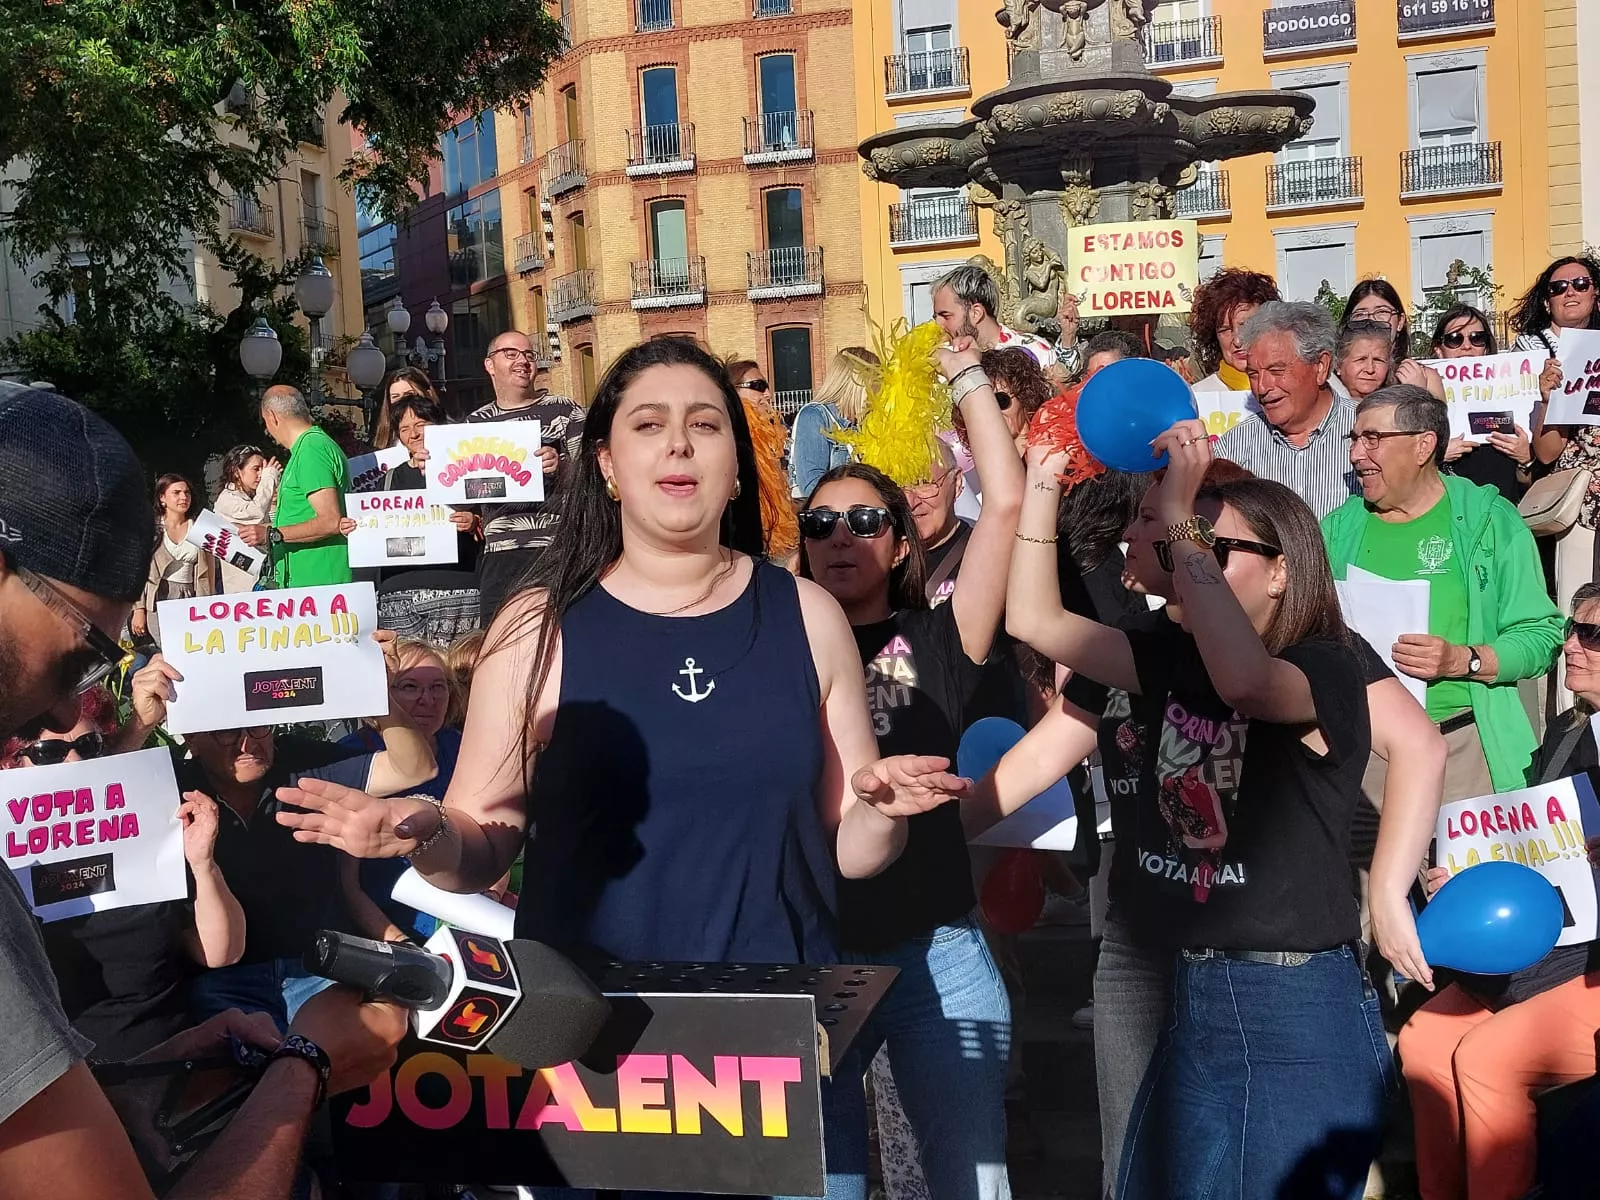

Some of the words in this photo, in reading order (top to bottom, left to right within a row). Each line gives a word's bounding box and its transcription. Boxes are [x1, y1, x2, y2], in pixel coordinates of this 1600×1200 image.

[1403, 3, 1426, 17] 611
[1431, 1, 1448, 14] 59
[1452, 0, 1469, 11] 16
[1473, 0, 1488, 9] 16
[1267, 12, 1351, 34] PODÓLOGO
[1084, 229, 1184, 252] ESTAMOS
[1092, 290, 1176, 310] LORENA
[1441, 359, 1511, 383] ORENA
[1520, 358, 1531, 374] A
[1564, 377, 1584, 396] LA
[360, 495, 424, 512] LORENA
[189, 596, 318, 623] LORENA
[330, 593, 349, 614] A
[184, 628, 226, 655] LA
[237, 612, 360, 653] FINAL!!!
[252, 677, 318, 694] JOTALENT
[272, 690, 297, 699] 2024
[6, 786, 95, 825] VOTA
[105, 782, 126, 810] A
[1447, 801, 1538, 840] LORENA
[1546, 796, 1568, 824] A
[5, 811, 140, 858] LORENA
[1138, 848, 1188, 883] VOTA
[1448, 847, 1481, 876] LA
[60, 882, 86, 892] 2024
[345, 1052, 801, 1138] JOTALENT
